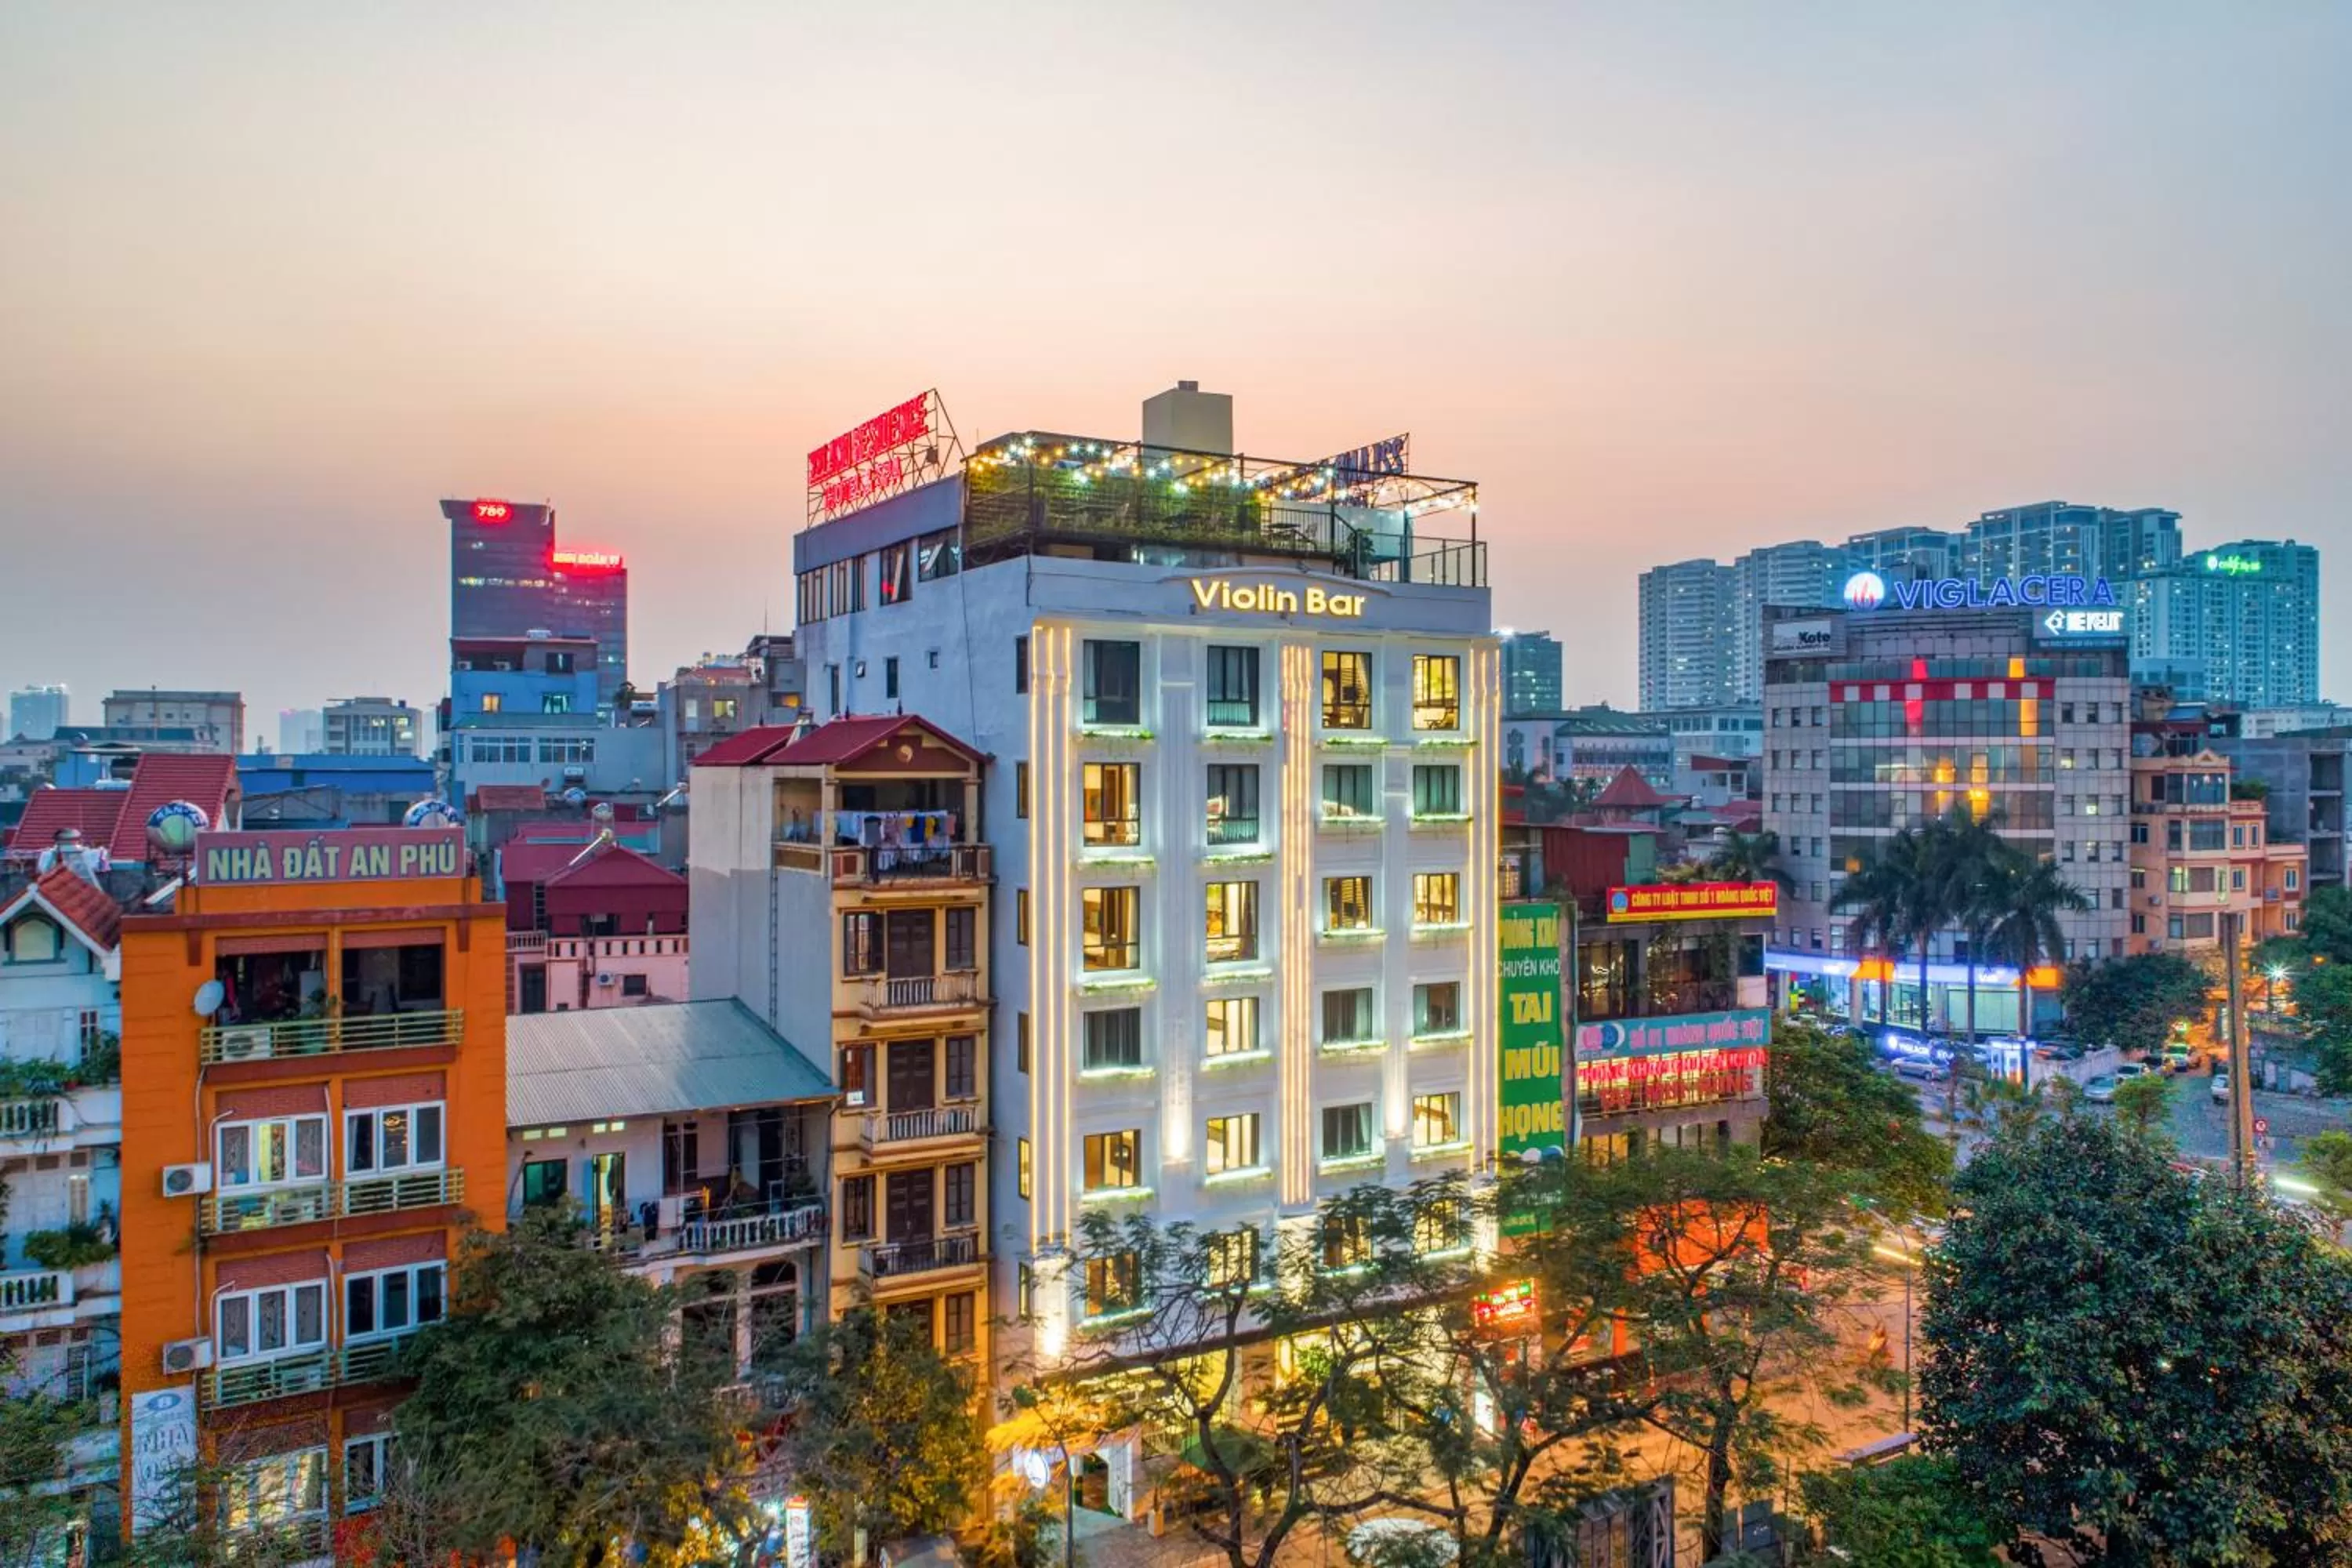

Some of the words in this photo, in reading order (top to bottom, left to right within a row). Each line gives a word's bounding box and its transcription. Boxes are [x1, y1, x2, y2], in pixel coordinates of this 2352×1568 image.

[1191, 579, 1298, 612] Violin
[1305, 587, 1367, 615] Bar
[1894, 575, 2115, 609] VIGLACERA
[207, 840, 273, 880] NHÀ
[283, 836, 339, 878] ĐẤT
[350, 844, 390, 877] AN
[400, 837, 456, 875] PHÚ
[1508, 990, 1552, 1024] TAI
[1504, 1040, 1559, 1080] MŨI
[1498, 1100, 1564, 1142] HỌNG
